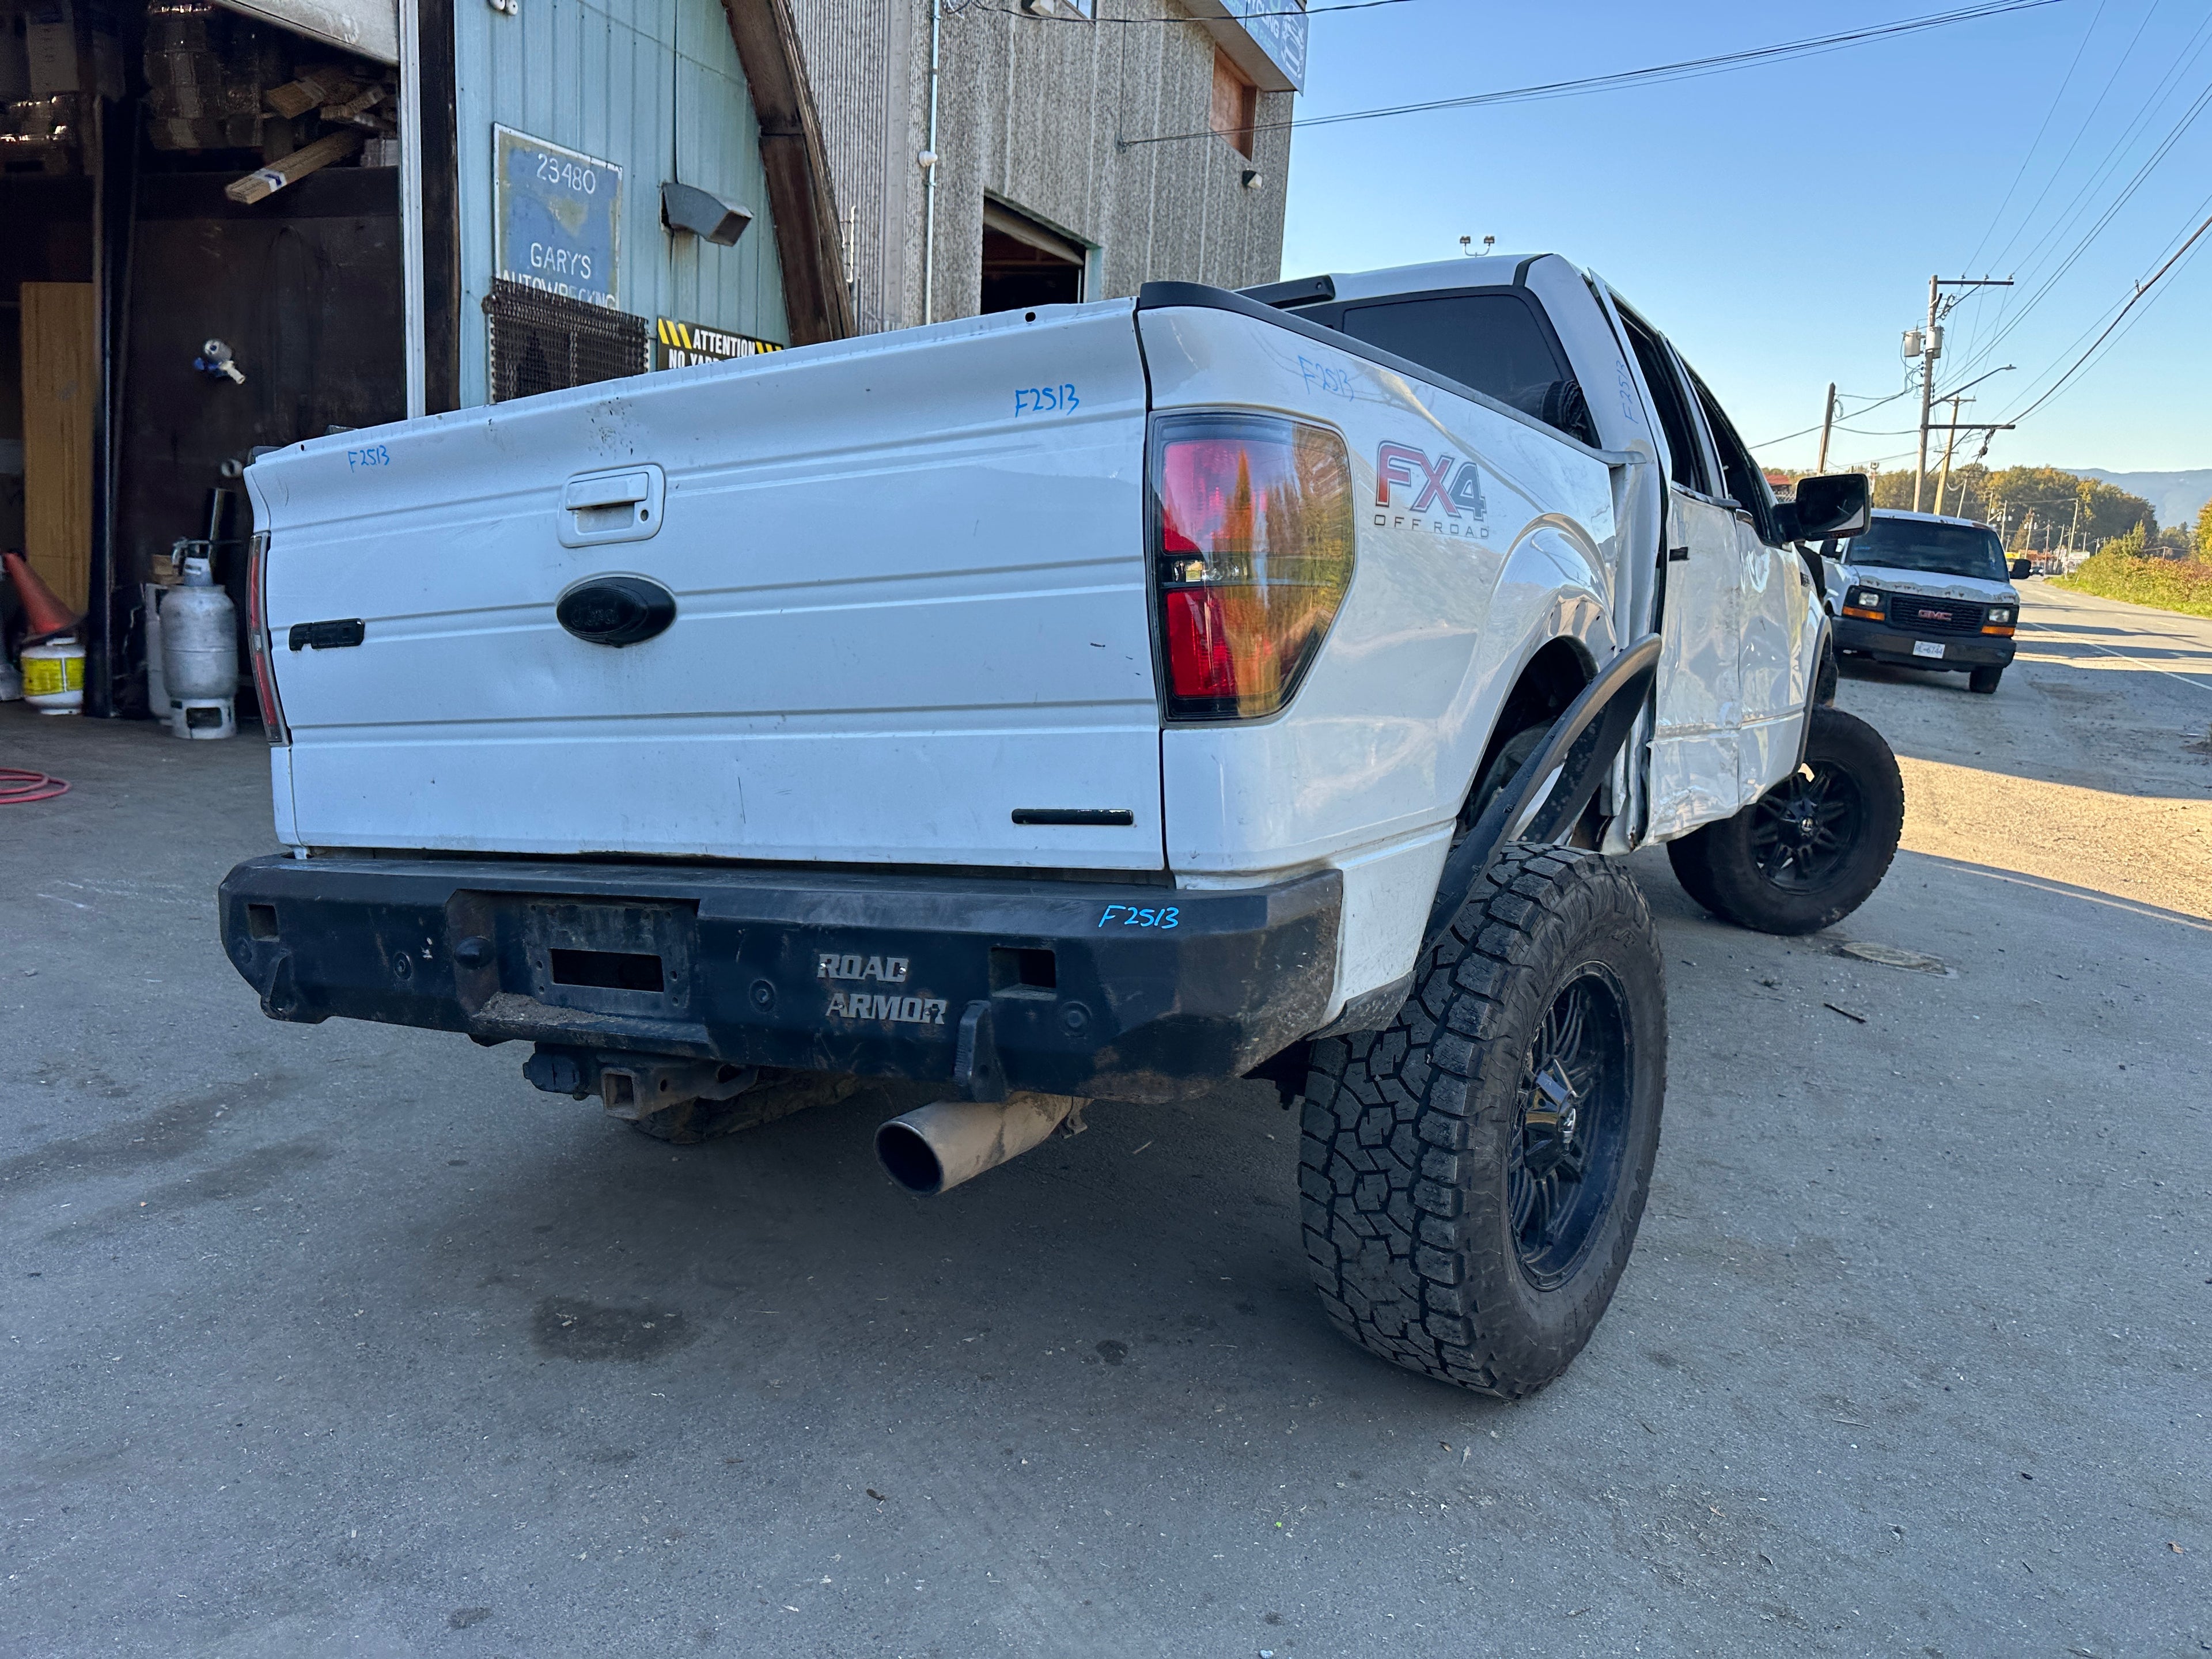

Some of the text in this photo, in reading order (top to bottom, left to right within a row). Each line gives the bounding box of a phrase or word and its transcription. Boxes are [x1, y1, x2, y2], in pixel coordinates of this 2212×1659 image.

[1246, 0, 1279, 39] YCLING
[536, 153, 596, 194] 23480
[531, 243, 591, 279] GARY'S
[693, 328, 755, 357] ATTENTION
[669, 349, 685, 369] NO
[1015, 384, 1080, 418] F2513
[348, 445, 390, 473] F2513
[1376, 440, 1487, 522] FX4
[1374, 514, 1489, 538] OFF ROAD
[1918, 609, 1953, 622] GMC
[1098, 904, 1180, 929] F2513
[817, 954, 909, 983] ROAD
[825, 993, 948, 1025] ARMOR
